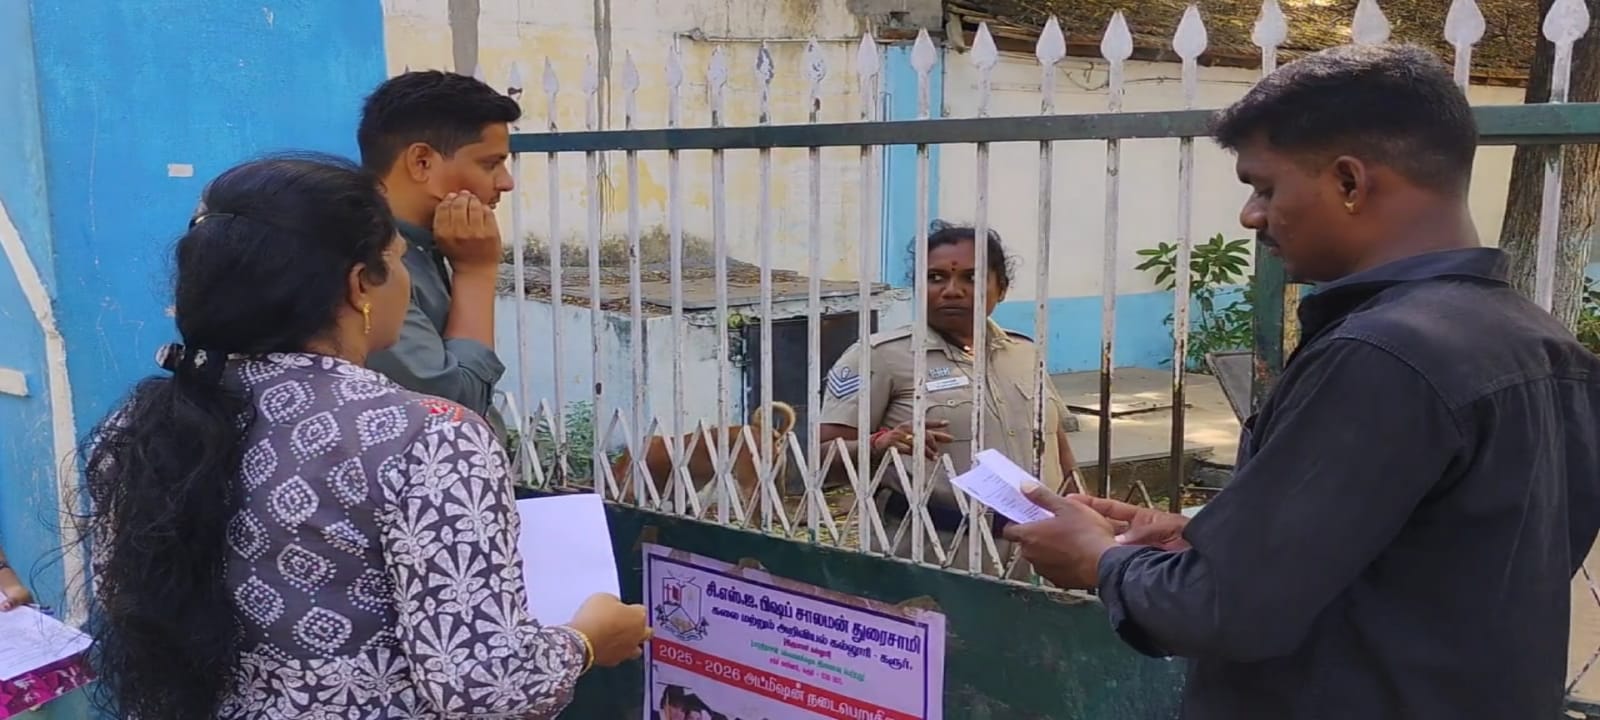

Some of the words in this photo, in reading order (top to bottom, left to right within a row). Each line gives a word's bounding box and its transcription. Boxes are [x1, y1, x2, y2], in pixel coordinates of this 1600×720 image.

[711, 606, 740, 621] கலை
[741, 613, 775, 630] மற்றும்
[829, 638, 872, 658] கல்லூரி
[760, 595, 793, 620] பிஷப்
[795, 607, 849, 634] சாலமன்
[851, 622, 921, 655] துரைசாமி
[658, 643, 694, 666] 2025
[704, 658, 742, 682] 2026
[743, 671, 805, 702] அட்மிஷன்
